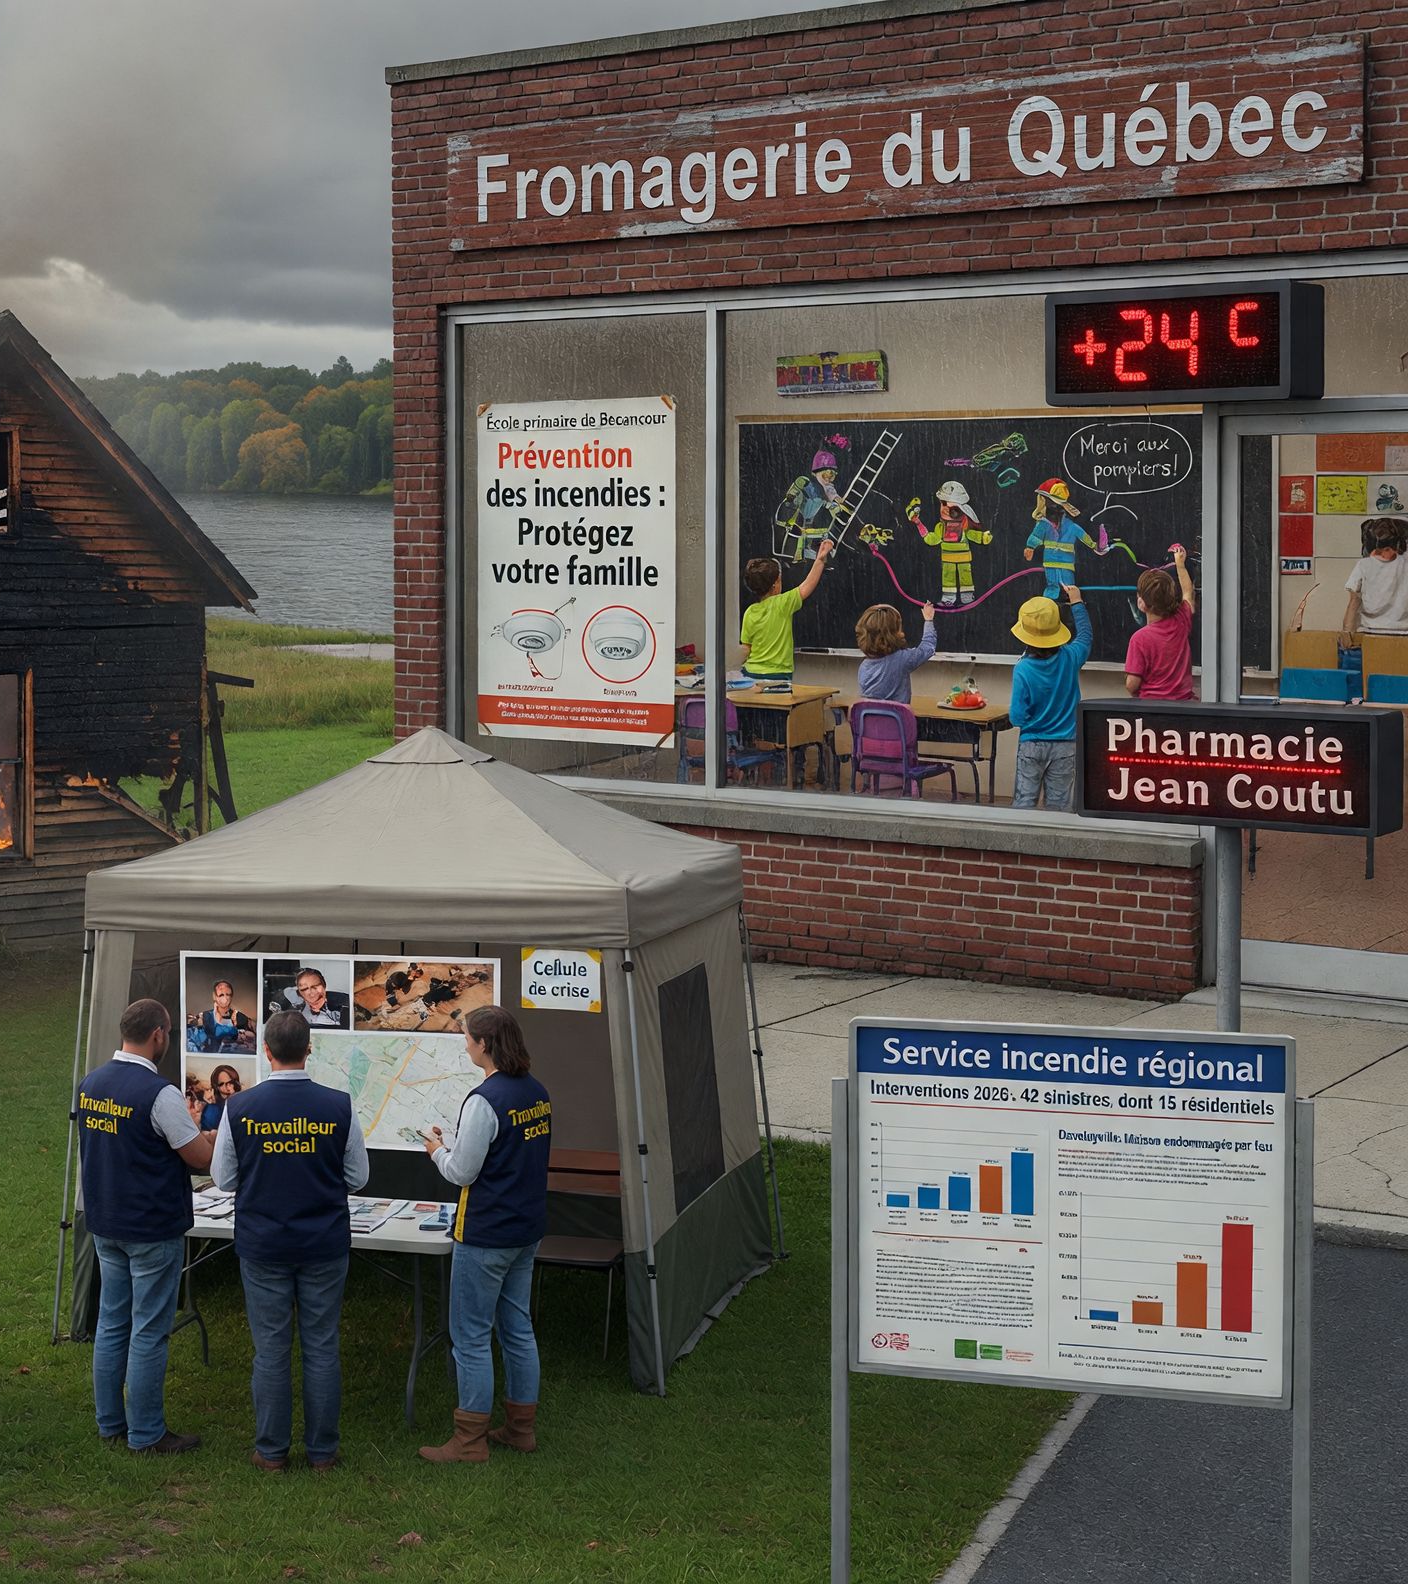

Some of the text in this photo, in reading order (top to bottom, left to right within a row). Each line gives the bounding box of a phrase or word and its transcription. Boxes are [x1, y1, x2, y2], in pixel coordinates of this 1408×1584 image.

[476, 81, 1328, 224] Fromagerie du Québec
[1074, 302, 1259, 381] +24 C
[486, 413, 520, 430] École
[523, 415, 577, 431] primaire
[581, 413, 596, 427] de
[498, 440, 632, 469] Prévention
[1137, 438, 1170, 452] aux
[486, 478, 665, 507] des incendies :
[518, 517, 634, 554] Protégez
[492, 555, 658, 586] votre famille
[1106, 718, 1343, 763] Pharmacie
[1107, 767, 1354, 815] Jean Coutu
[533, 959, 587, 977] Cellule
[529, 981, 590, 998] de crise
[883, 1037, 1263, 1086] Service incendie régional
[870, 1080, 969, 1100] Interventions
[1020, 1088, 1039, 1103] 42
[1118, 1093, 1153, 1110] dont
[1158, 1096, 1176, 1111] 15
[1182, 1097, 1275, 1116] résidentiels
[241, 1117, 337, 1136] Travailleur
[263, 1136, 316, 1153] social
